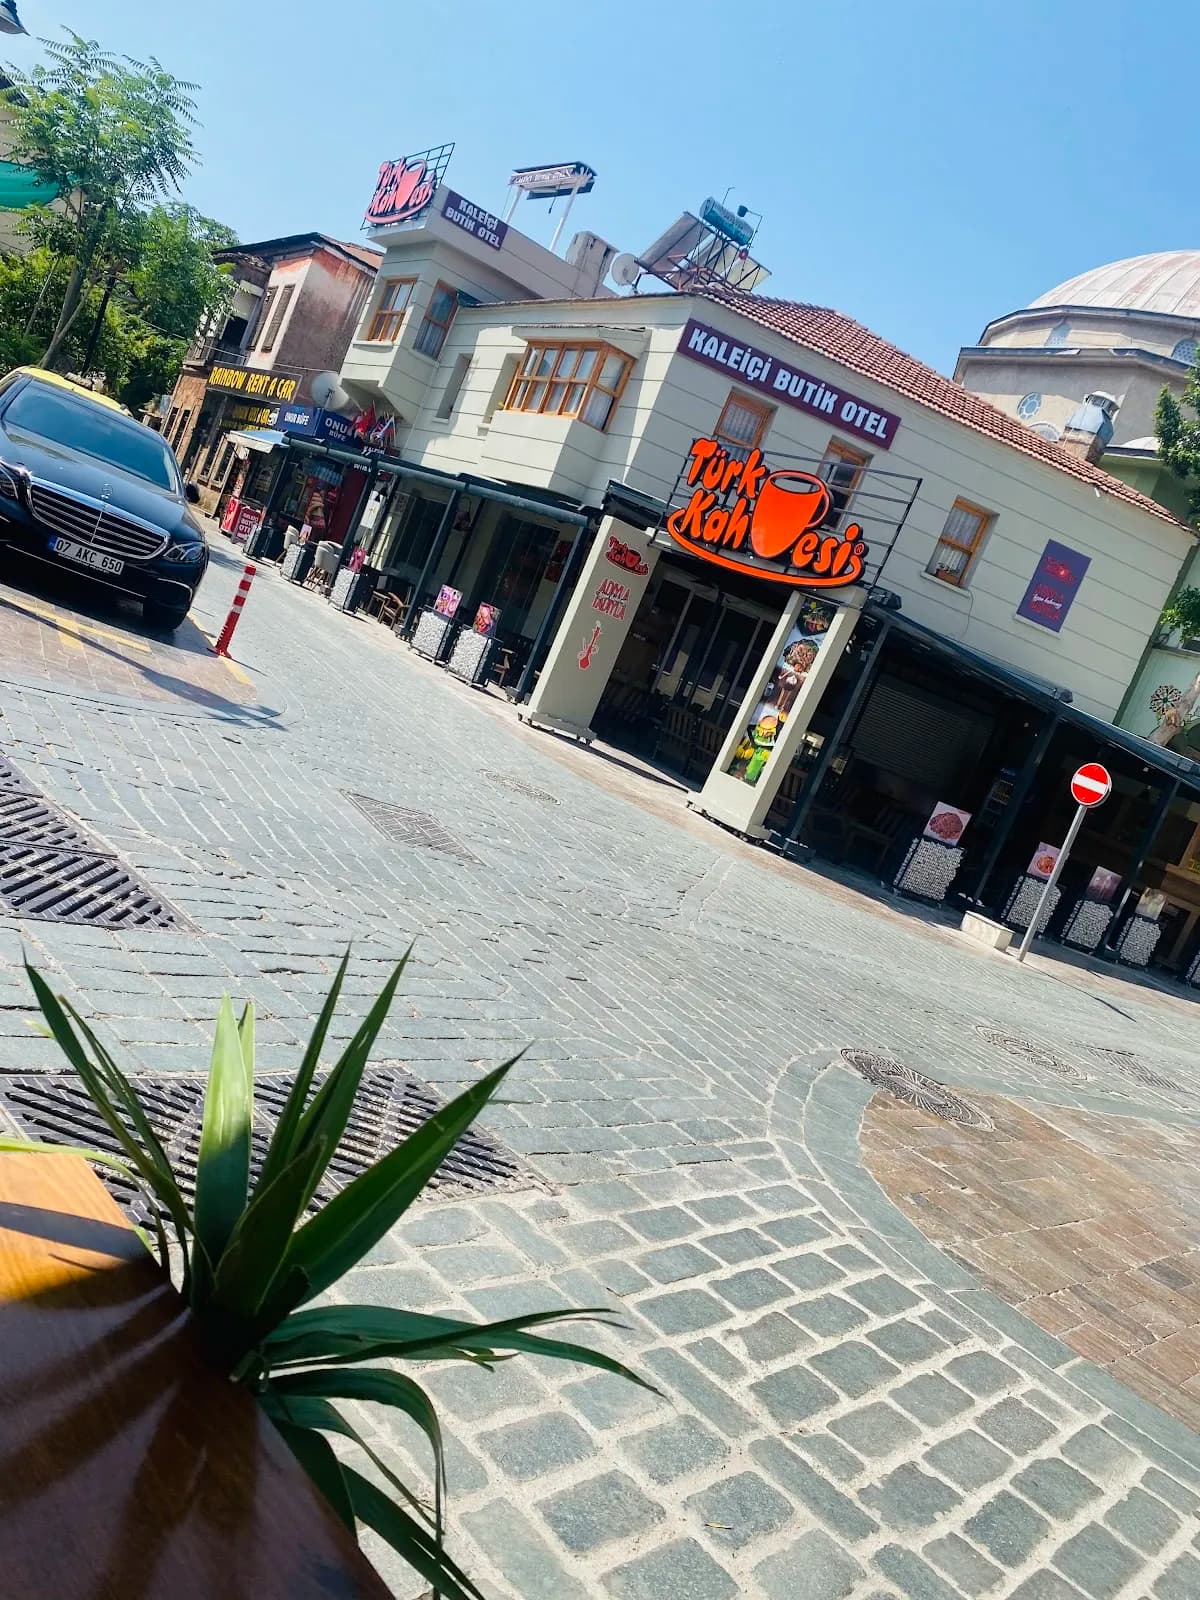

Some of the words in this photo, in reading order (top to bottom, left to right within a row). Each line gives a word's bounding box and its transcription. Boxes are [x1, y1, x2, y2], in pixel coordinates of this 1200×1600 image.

[445, 206, 475, 233] BUTİK
[477, 228, 501, 248] OTEL
[459, 199, 498, 232] KALEİÇİ
[208, 366, 246, 391] RAINBOW
[246, 373, 270, 395] RENT
[266, 379, 275, 397] A
[276, 380, 297, 401] CAR
[688, 327, 773, 382] KALEİÇİ
[773, 367, 839, 414] BUTİK
[840, 402, 888, 439] OTEL
[686, 437, 768, 499] Türk
[56, 539, 72, 553] 07
[75, 547, 97, 563] AKC
[101, 556, 122, 573] 650
